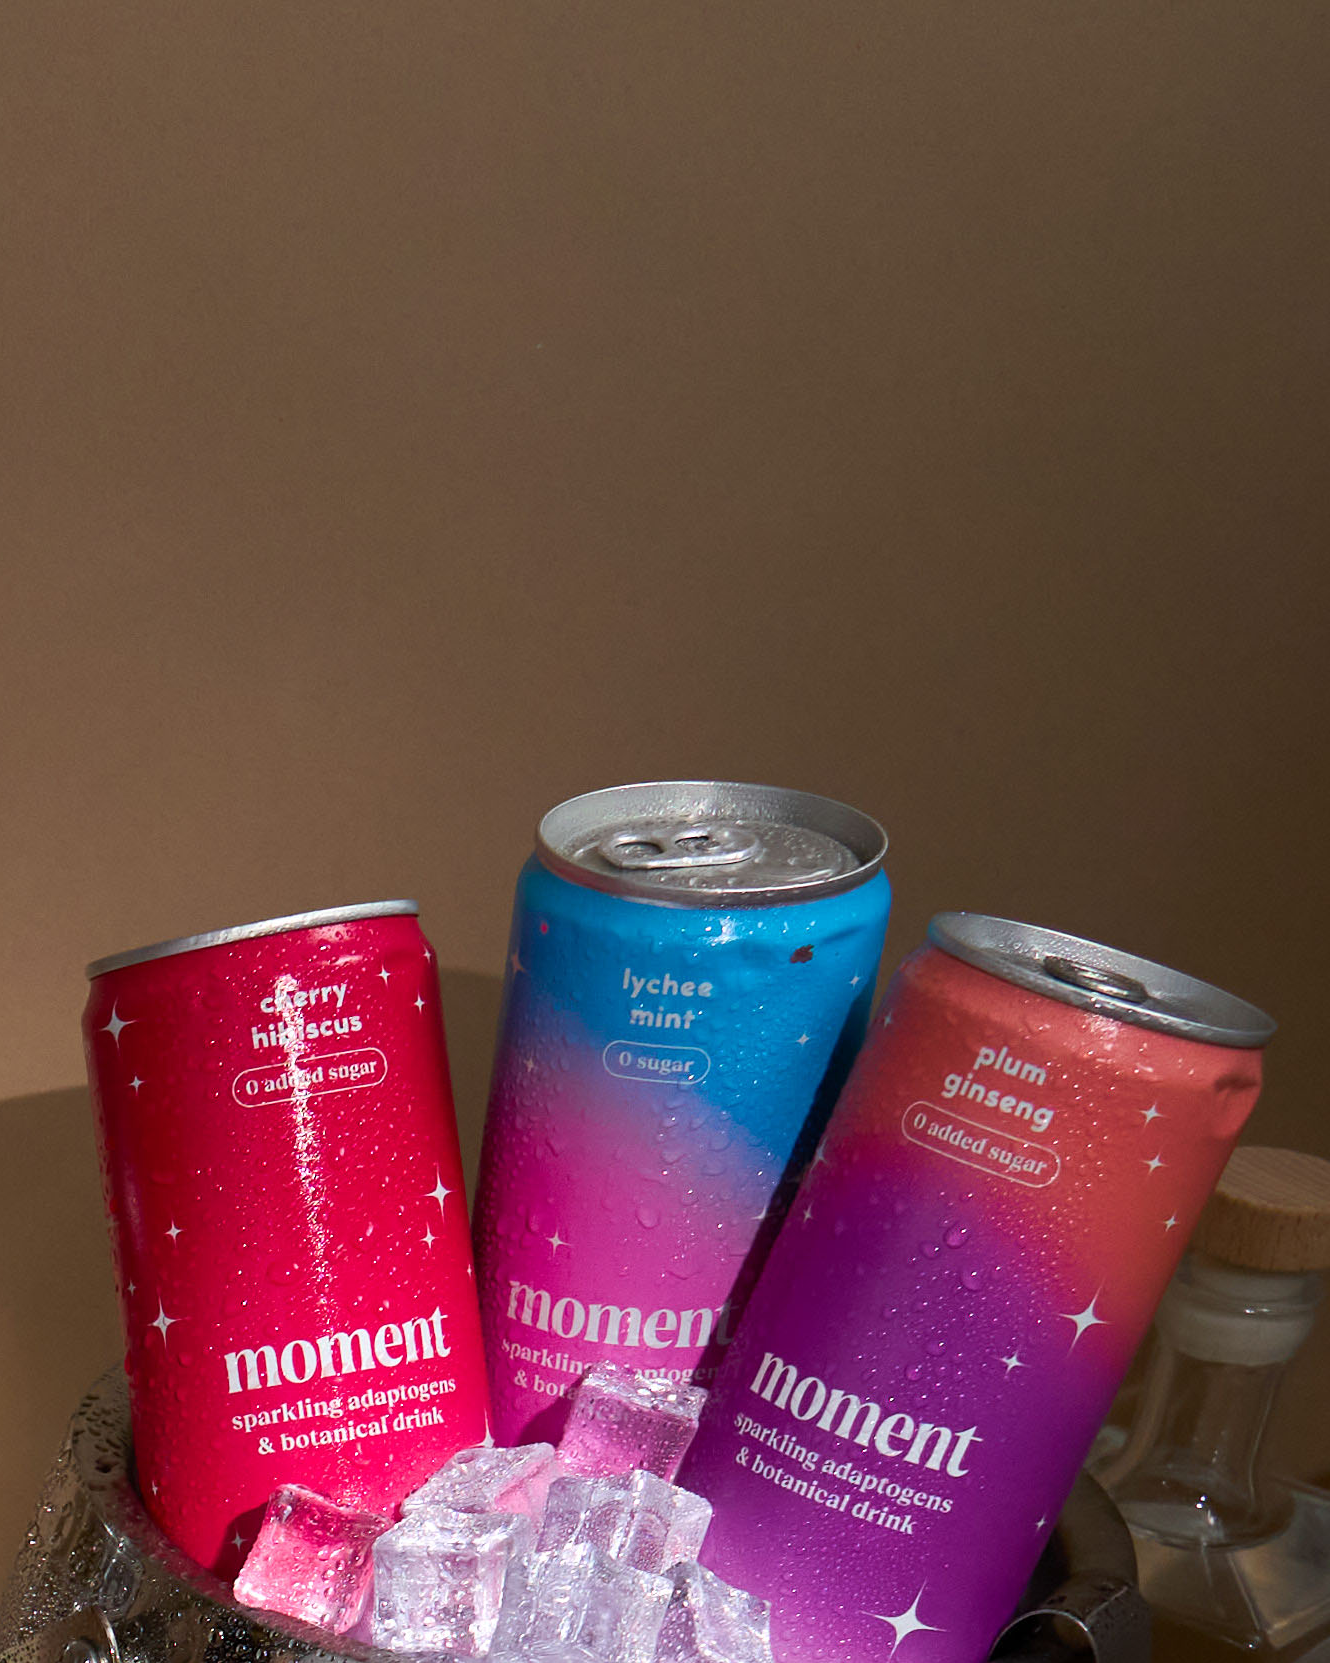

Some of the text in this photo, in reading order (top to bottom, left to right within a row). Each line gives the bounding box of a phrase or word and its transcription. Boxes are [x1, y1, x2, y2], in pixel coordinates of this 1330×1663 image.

[260, 982, 347, 1014] cherry
[622, 967, 713, 998] lychee
[251, 1015, 363, 1049] hibiscus
[629, 1006, 695, 1029] mint
[328, 1060, 377, 1081] sugar
[637, 1056, 695, 1075] sugar
[973, 1046, 1047, 1086] plum
[941, 1072, 1054, 1132] ginseng
[927, 1122, 988, 1155] added
[987, 1144, 1048, 1175] sugar
[507, 1280, 739, 1349] moment
[223, 1306, 451, 1394] moment
[514, 1369, 528, 1388] &
[231, 1378, 457, 1433] sparkling adaptogens
[749, 1352, 984, 1478] moment
[257, 1406, 445, 1455] & botanical drink
[733, 1412, 954, 1514] sparkling adaptogens
[735, 1446, 918, 1535] & botanical drink
